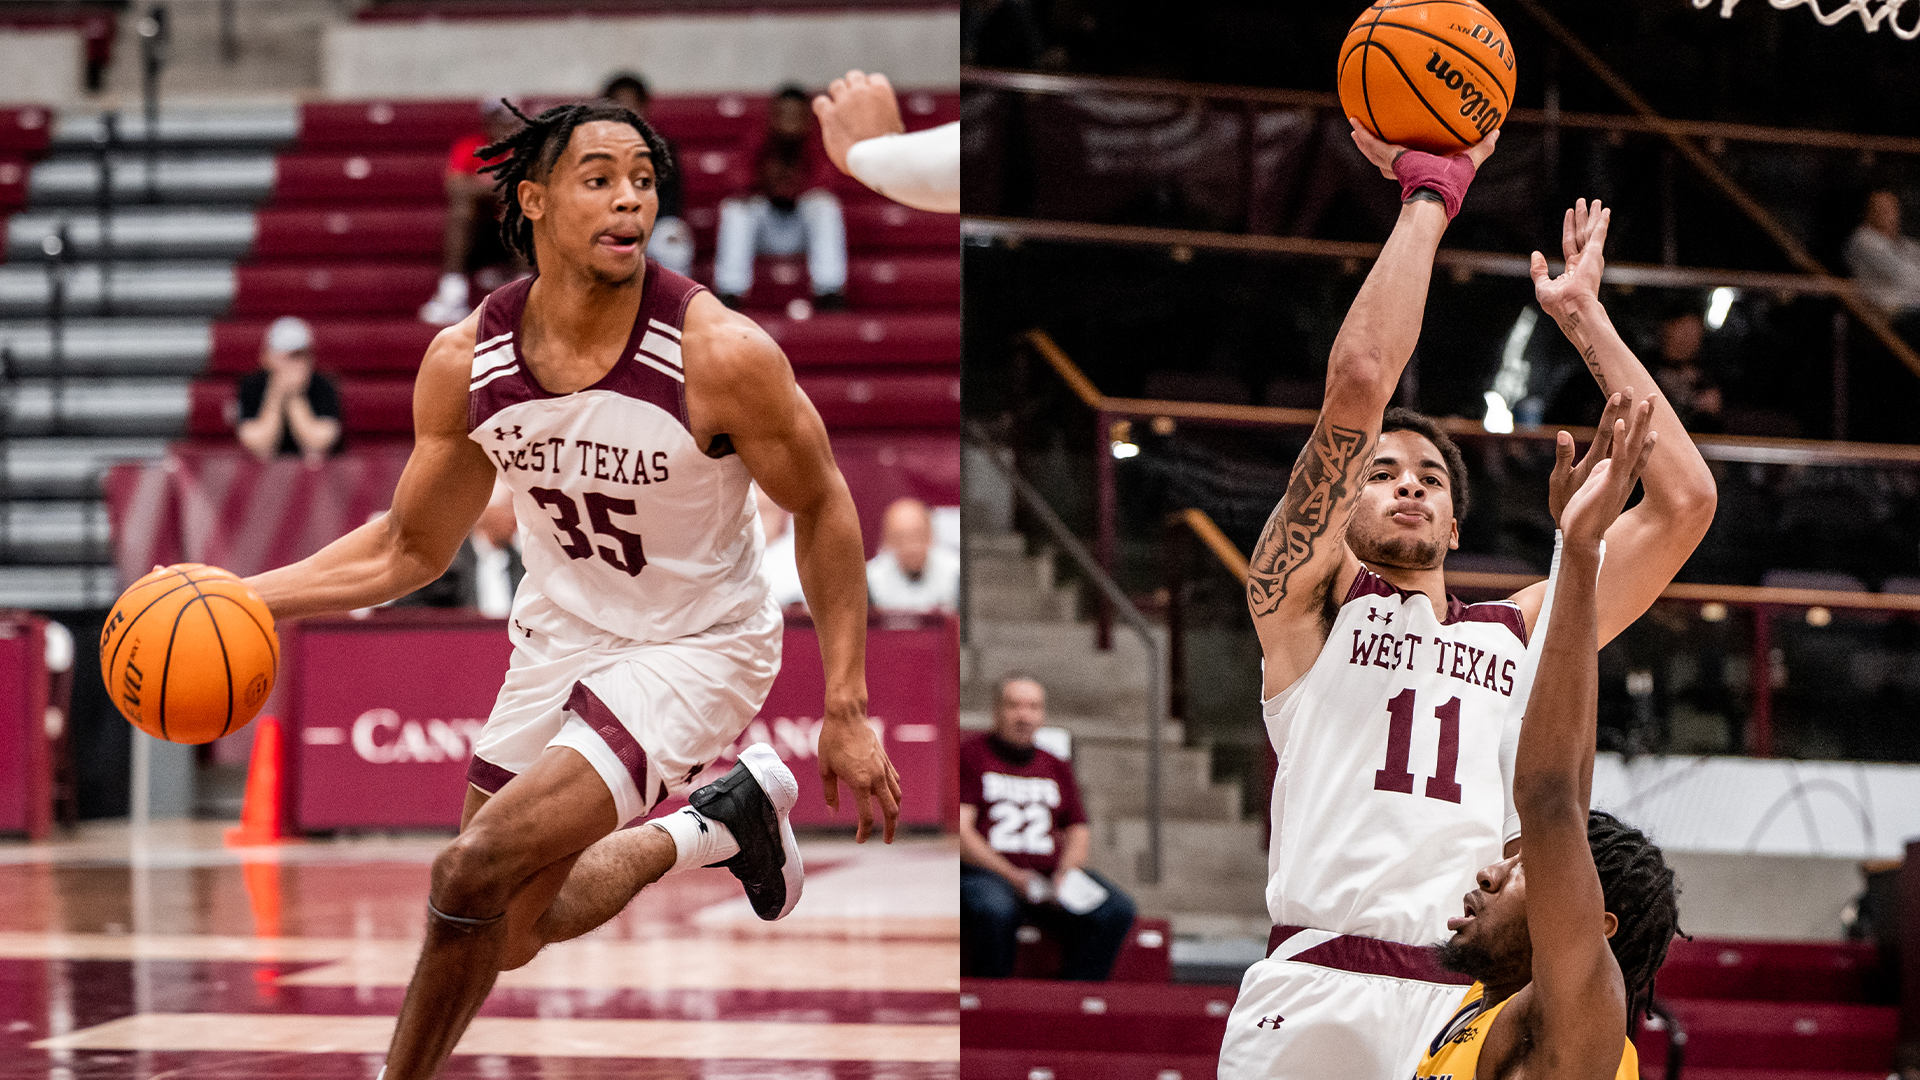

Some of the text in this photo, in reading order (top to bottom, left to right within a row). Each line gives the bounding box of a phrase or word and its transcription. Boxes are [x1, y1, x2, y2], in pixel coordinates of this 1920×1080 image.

[1446, 22, 1514, 72] EVO NXT
[1425, 51, 1502, 137] Wilson
[492, 437, 669, 485] WEST TEXAS
[528, 486, 648, 577] 35
[1349, 629, 1516, 698] WEST TEXAS
[1374, 687, 1462, 805] 11
[988, 801, 1055, 855] 22
